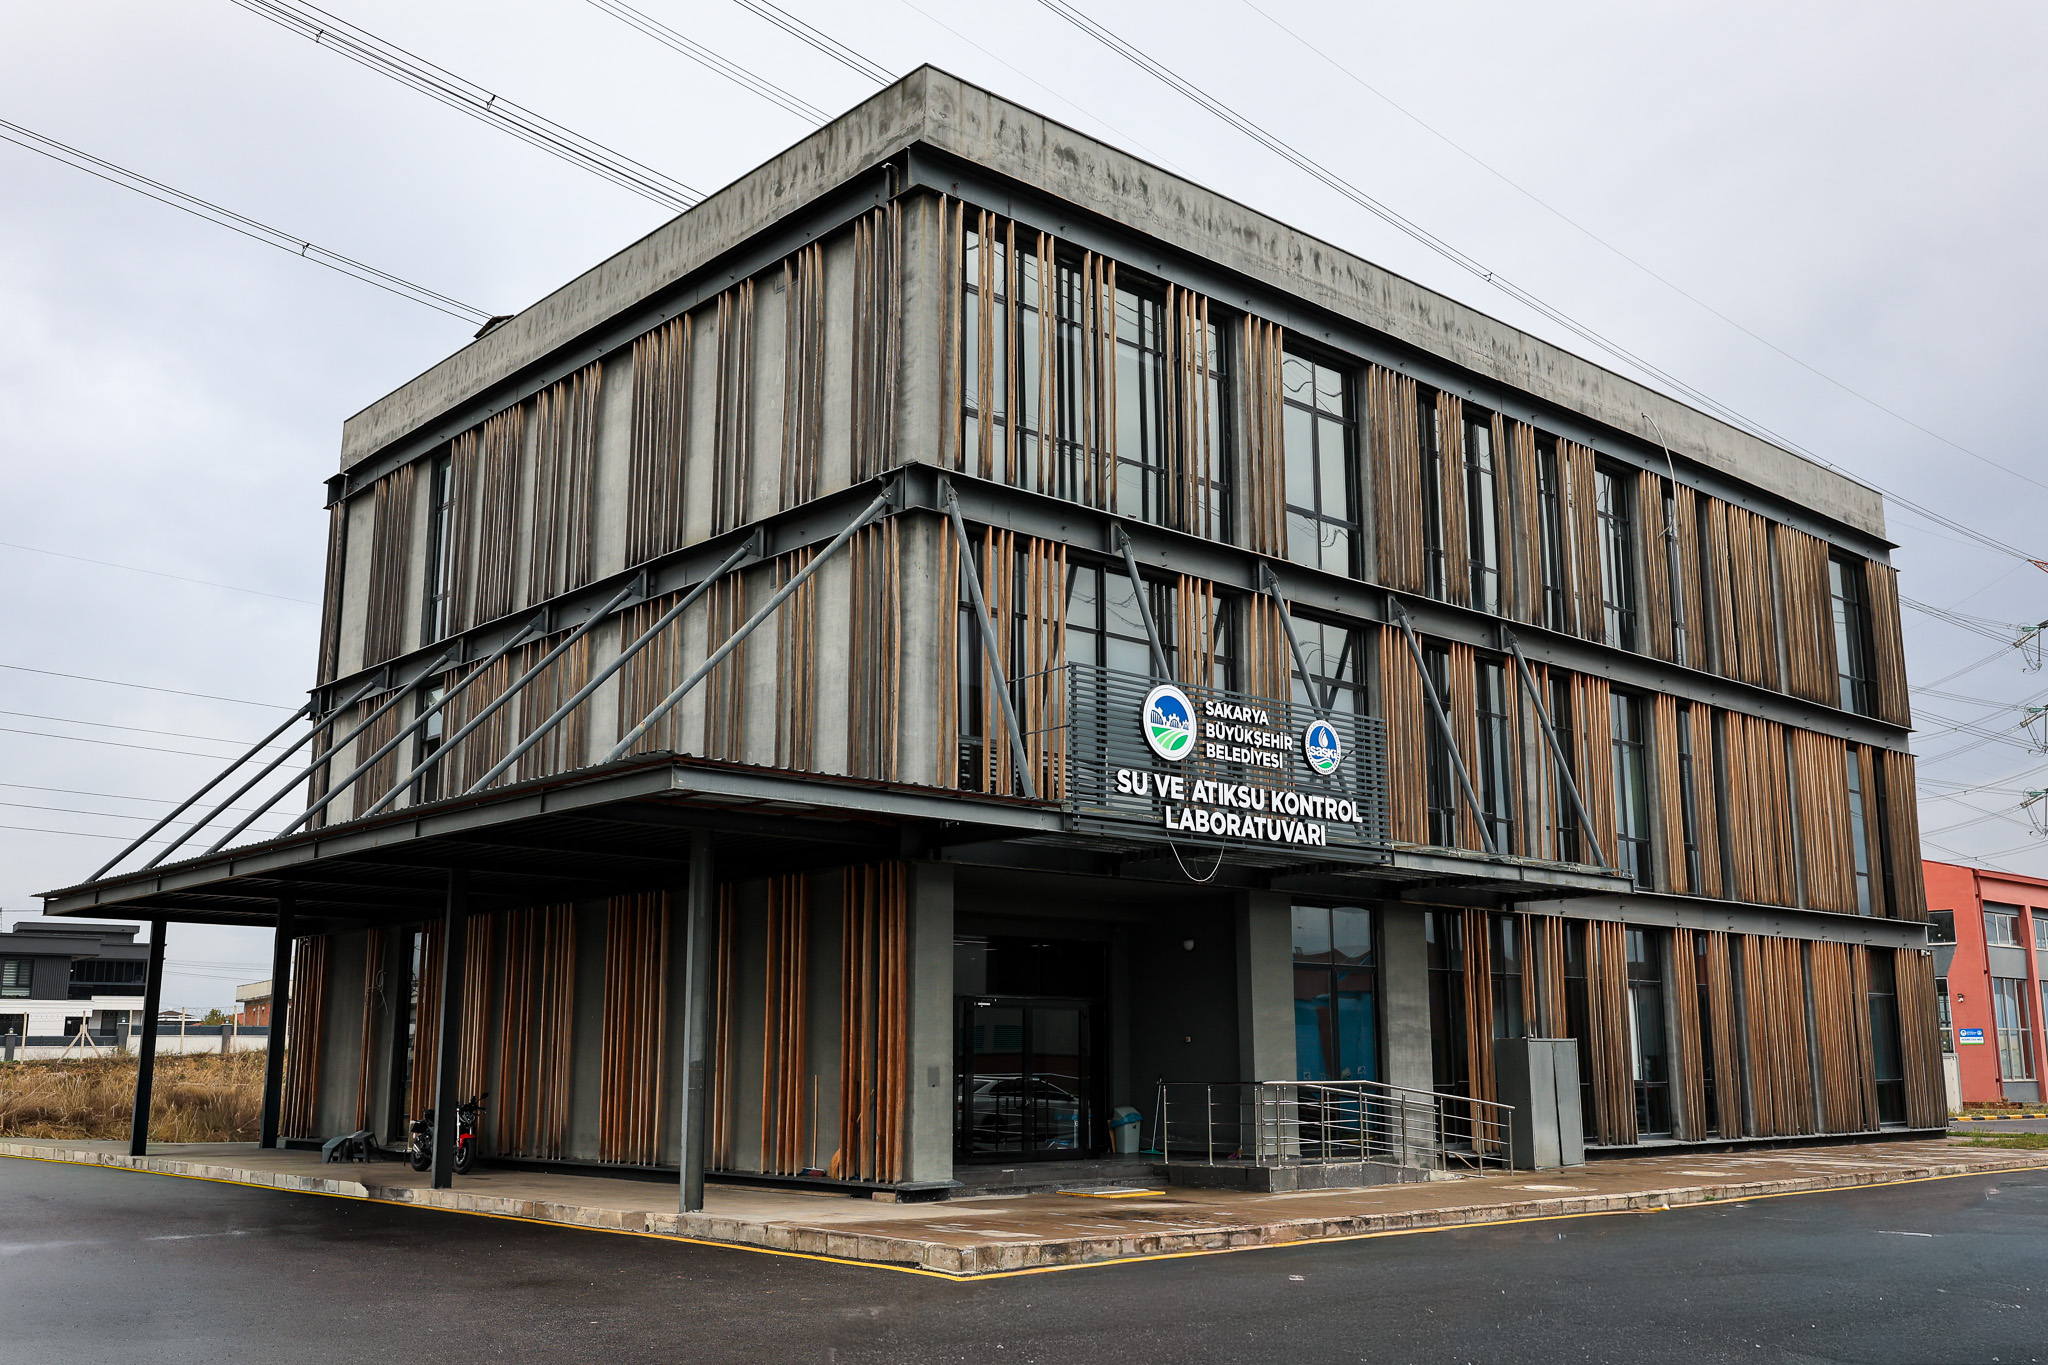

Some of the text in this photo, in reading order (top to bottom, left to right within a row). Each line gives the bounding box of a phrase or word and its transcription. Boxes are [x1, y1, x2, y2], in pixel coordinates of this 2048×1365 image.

[1205, 701, 1269, 726] SAKARYA
[1206, 721, 1293, 751] BÜYÜKŞEHİR
[1206, 742, 1283, 769] BELEDİYESİ
[1117, 769, 1363, 823] SU VE ATIKSU KONTROL
[1165, 805, 1326, 846] LABORATUVARI
